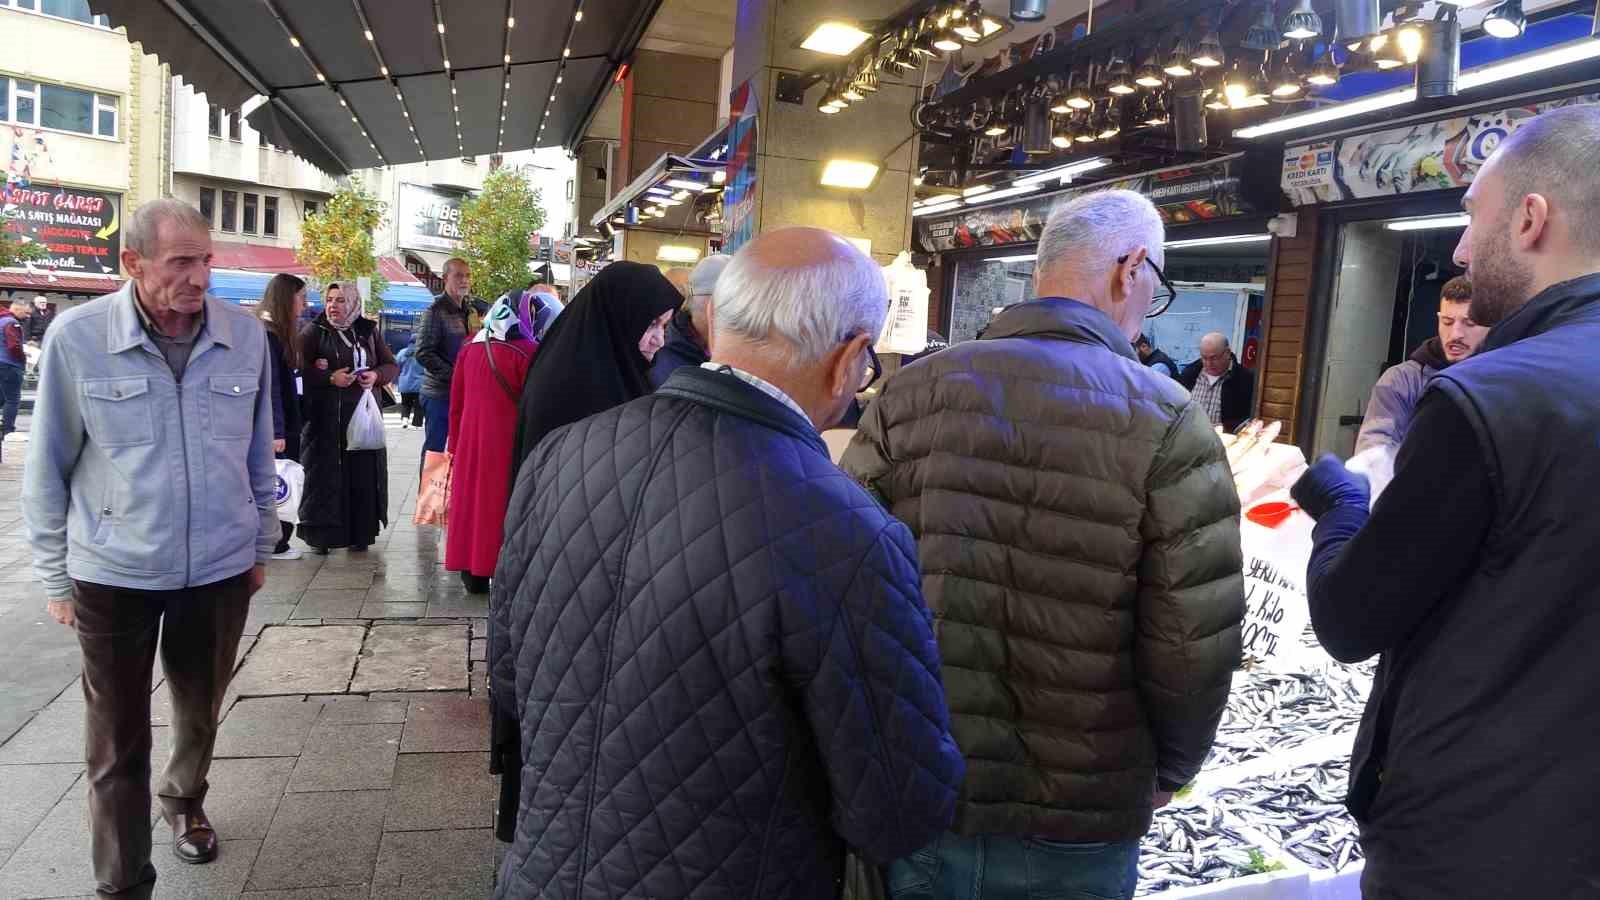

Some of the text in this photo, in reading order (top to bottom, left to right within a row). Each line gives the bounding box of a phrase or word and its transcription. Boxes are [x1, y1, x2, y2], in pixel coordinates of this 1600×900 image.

[28, 211, 55, 224] SATIŞ
[56, 213, 102, 226] MAĞAZASI
[1256, 590, 1284, 624] Kilo
